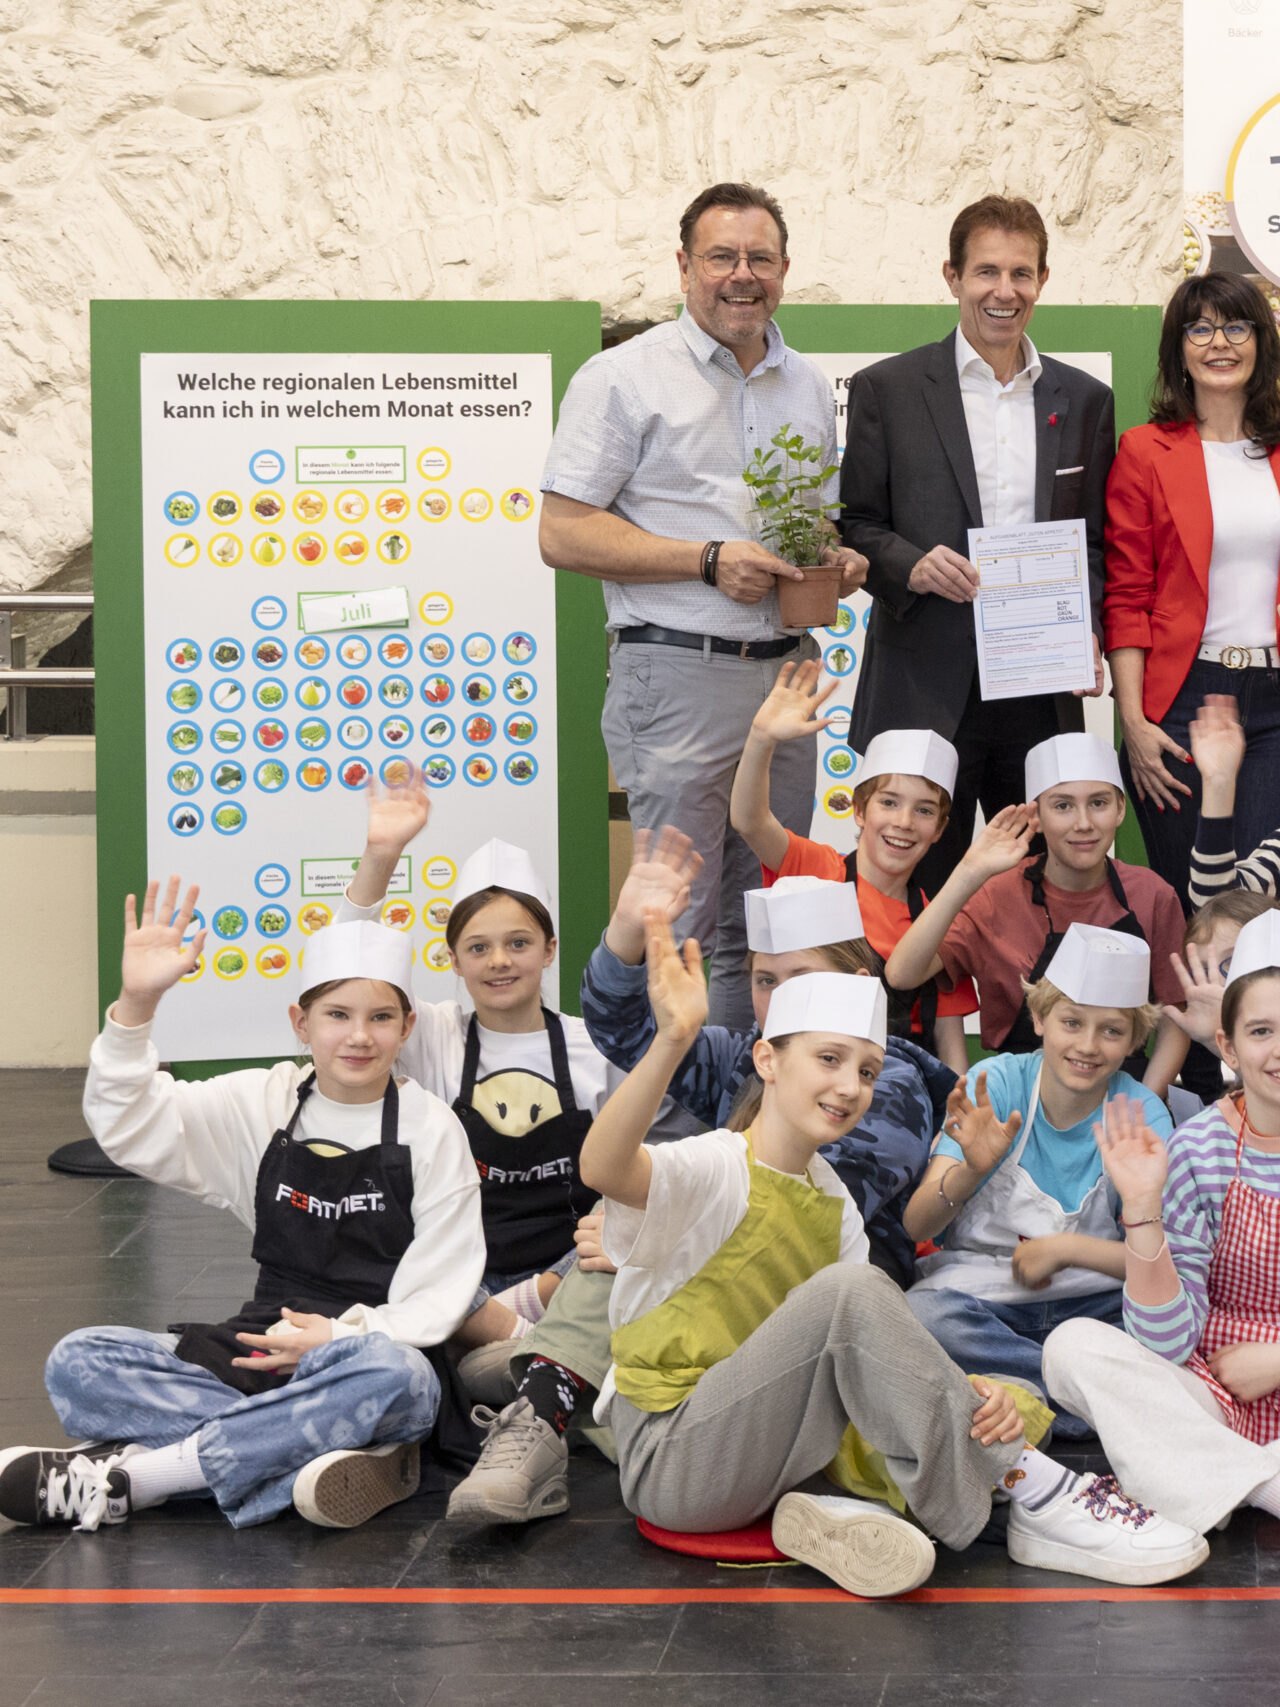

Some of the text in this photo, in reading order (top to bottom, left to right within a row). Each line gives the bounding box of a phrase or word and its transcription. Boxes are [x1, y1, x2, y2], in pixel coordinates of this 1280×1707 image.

[1227, 27, 1263, 38] Bäcker
[177, 371, 518, 394] Welche regionalen Lebensmittel
[163, 399, 532, 418] kann ich in welchem Monat essen?
[339, 602, 373, 622] Juli
